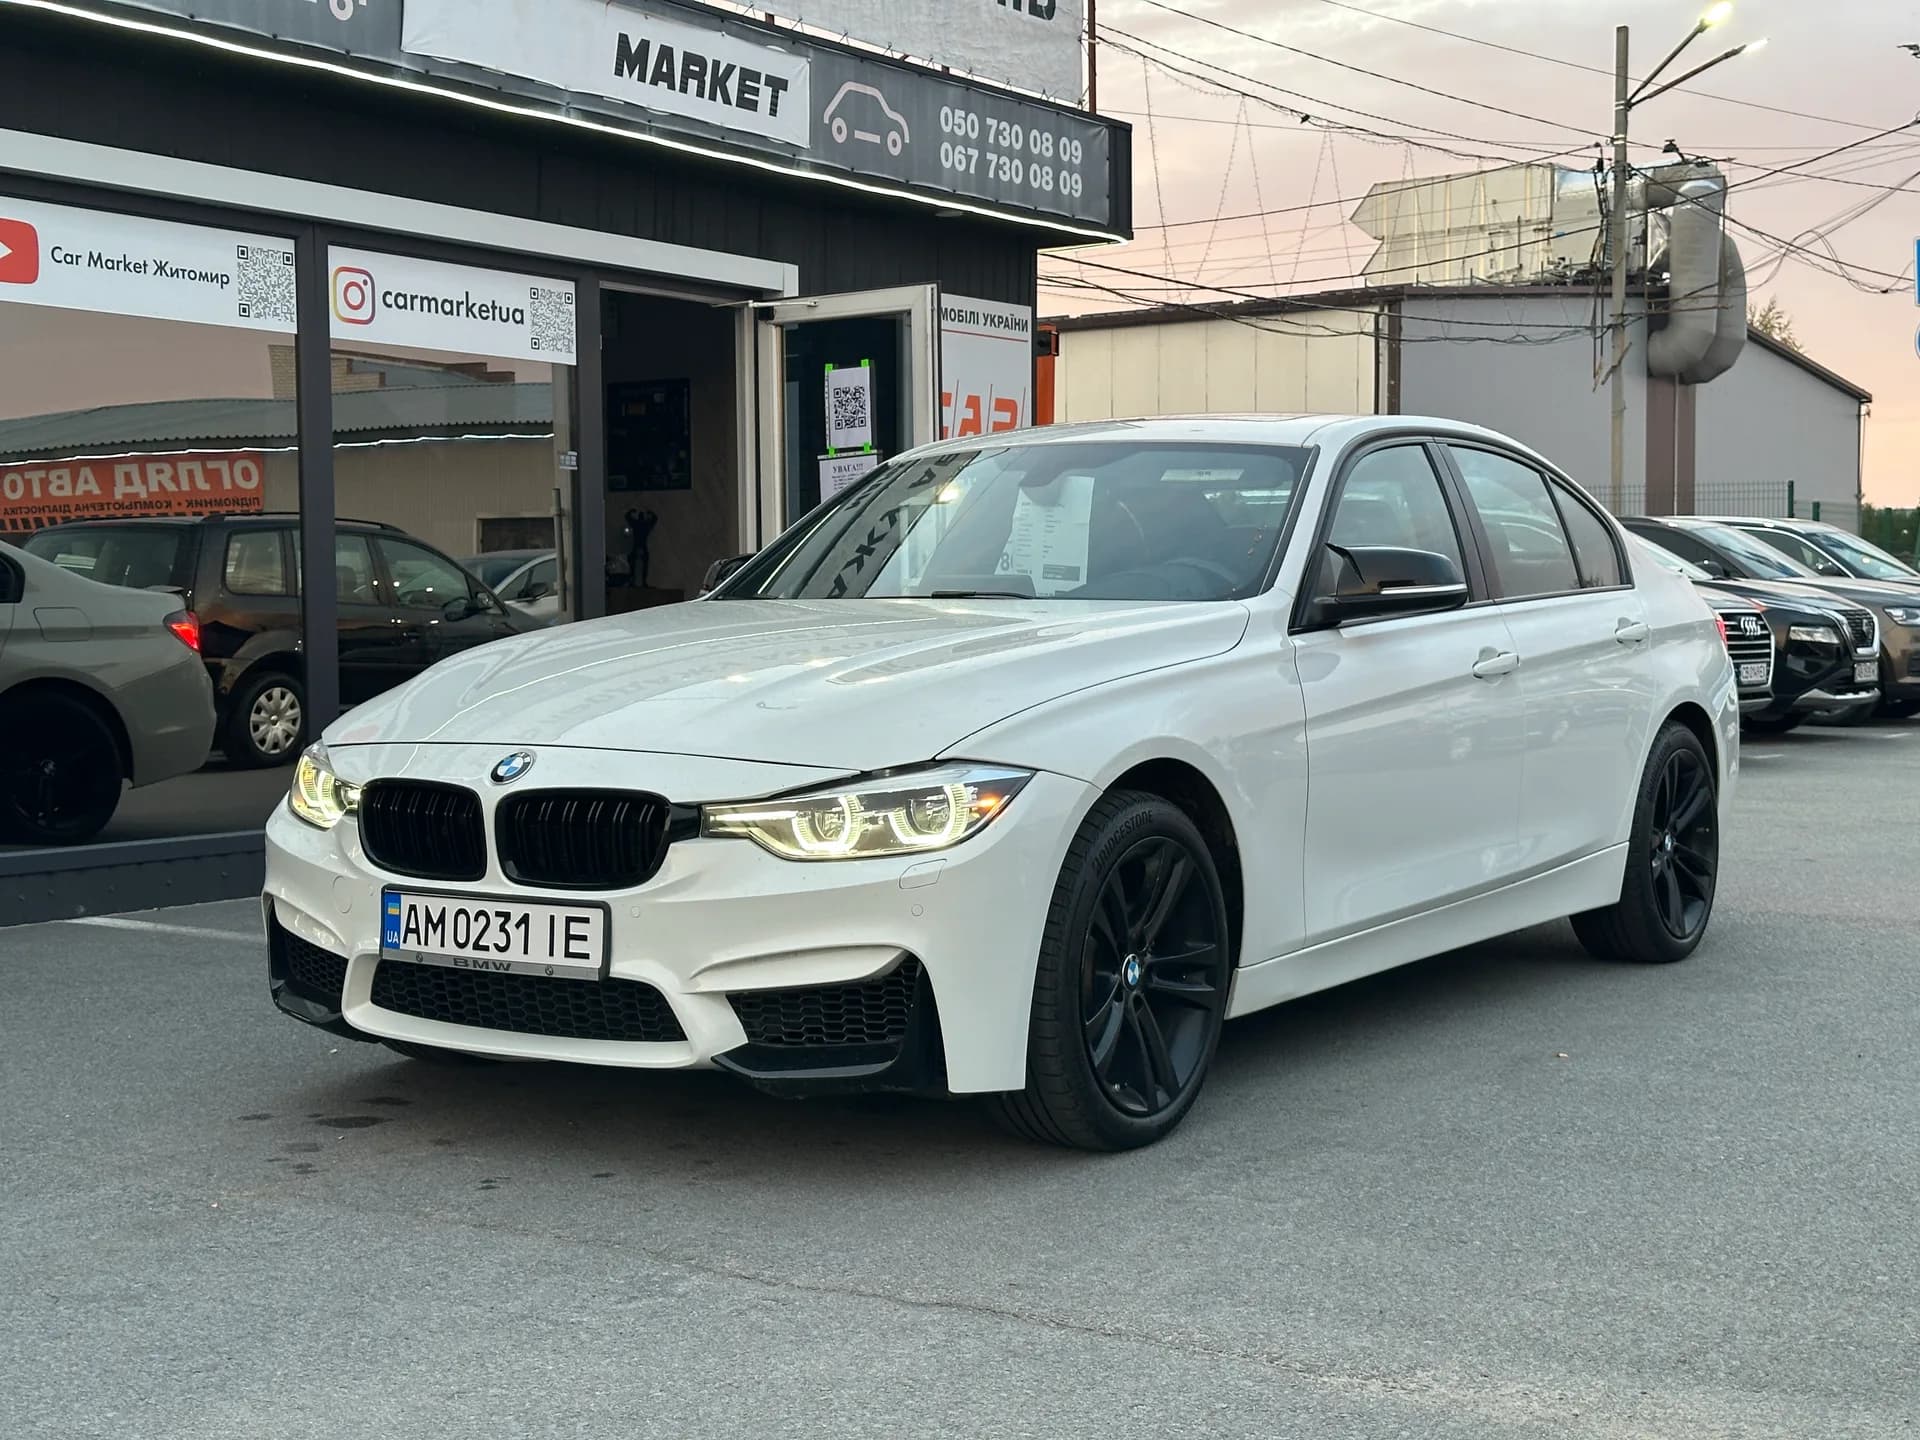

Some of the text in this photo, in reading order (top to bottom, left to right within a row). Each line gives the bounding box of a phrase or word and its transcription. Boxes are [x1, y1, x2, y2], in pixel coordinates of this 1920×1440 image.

[614, 32, 788, 117] MARKET
[940, 106, 1082, 164] 050 730 08 09
[940, 142, 1082, 198] 067 730 08 09
[51, 246, 230, 289] Car Market Житомир
[382, 290, 525, 325] carmarketua
[982, 312, 1028, 333] УКРАЇНИ
[387, 930, 399, 943] UA
[402, 904, 590, 960] AM 0231 IE
[453, 957, 512, 972] BMW
